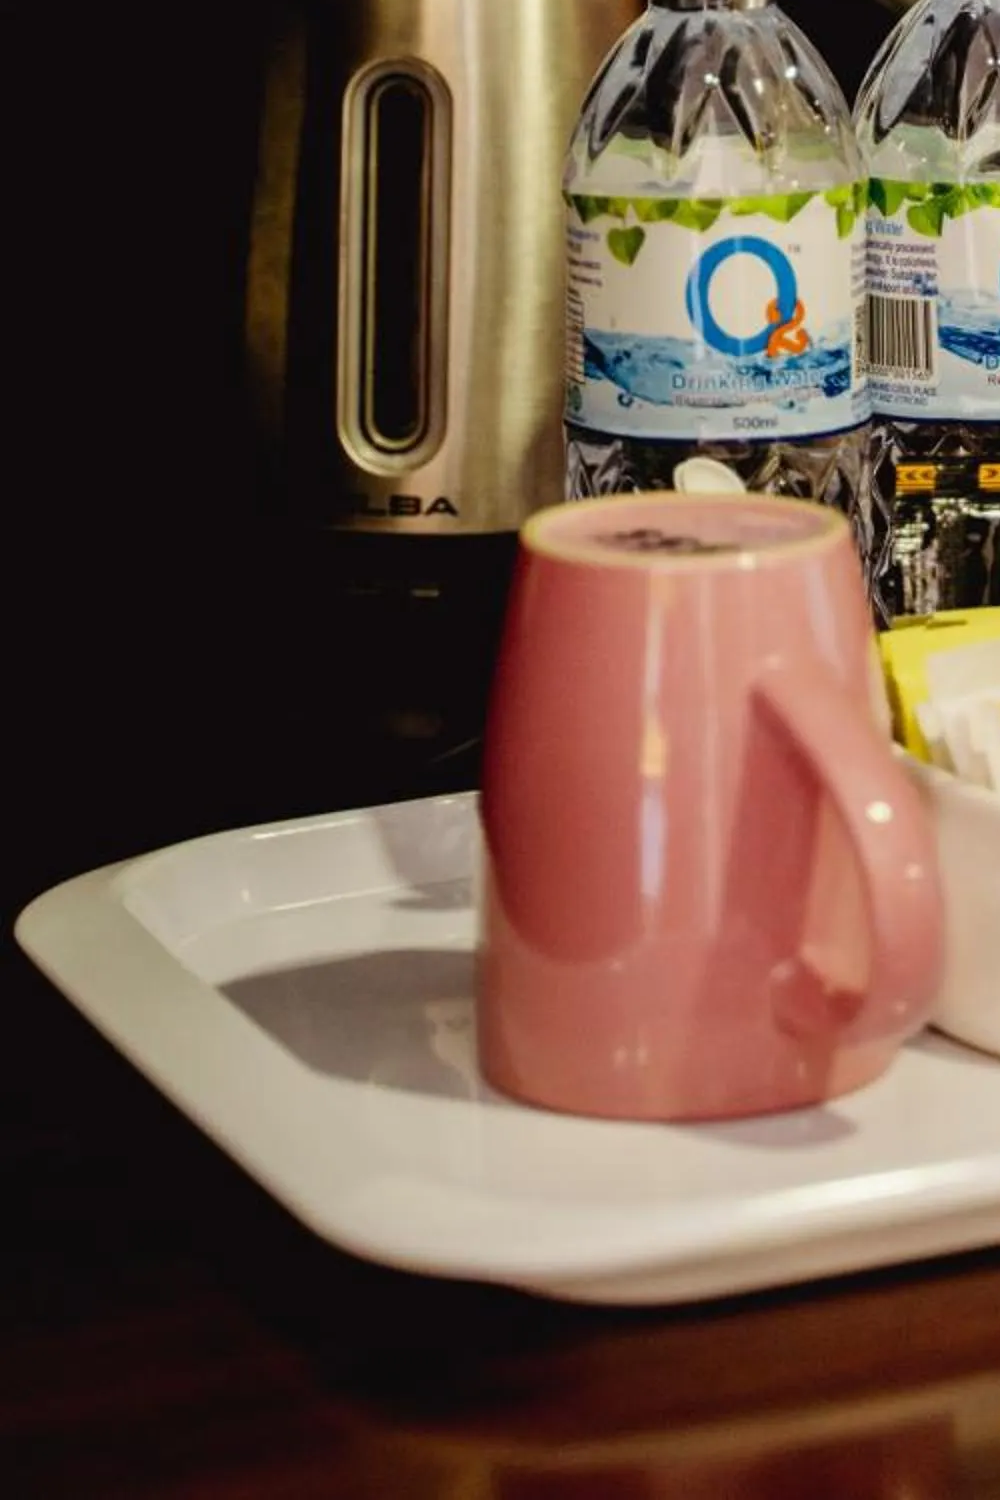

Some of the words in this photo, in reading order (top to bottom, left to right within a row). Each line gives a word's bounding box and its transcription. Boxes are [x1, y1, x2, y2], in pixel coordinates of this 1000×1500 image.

[672, 371, 767, 392] Drinking
[775, 368, 826, 387] Water
[733, 413, 779, 430] 500ml
